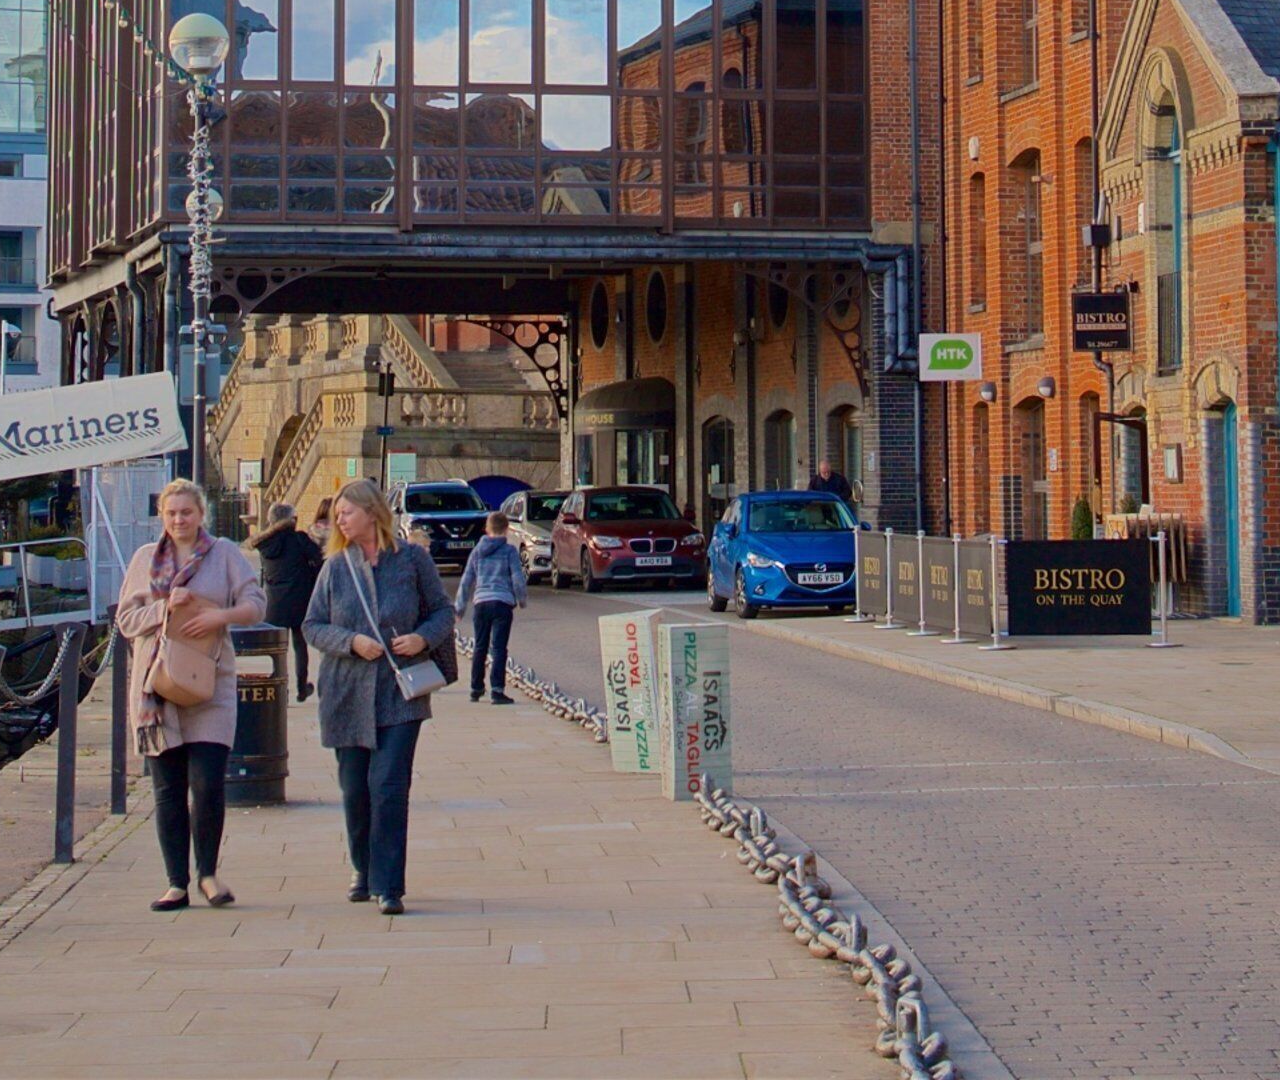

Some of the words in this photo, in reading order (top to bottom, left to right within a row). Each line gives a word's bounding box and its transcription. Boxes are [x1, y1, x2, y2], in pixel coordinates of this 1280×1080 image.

[1076, 312, 1127, 323] BISTRO
[936, 348, 968, 360] HTK
[1033, 568, 1126, 590] BISTRO
[1036, 594, 1055, 605] ON
[1060, 594, 1085, 605] THE
[1090, 594, 1124, 607] QUAY
[625, 622, 642, 688] TAGLIO
[683, 631, 698, 687] PIZZA
[613, 659, 631, 732] ISAACS
[632, 693, 645, 716] AL
[685, 691, 699, 716] AL
[702, 671, 721, 751] ISAACS
[635, 719, 651, 770] PIZZA
[686, 721, 702, 793] TAGLIO
